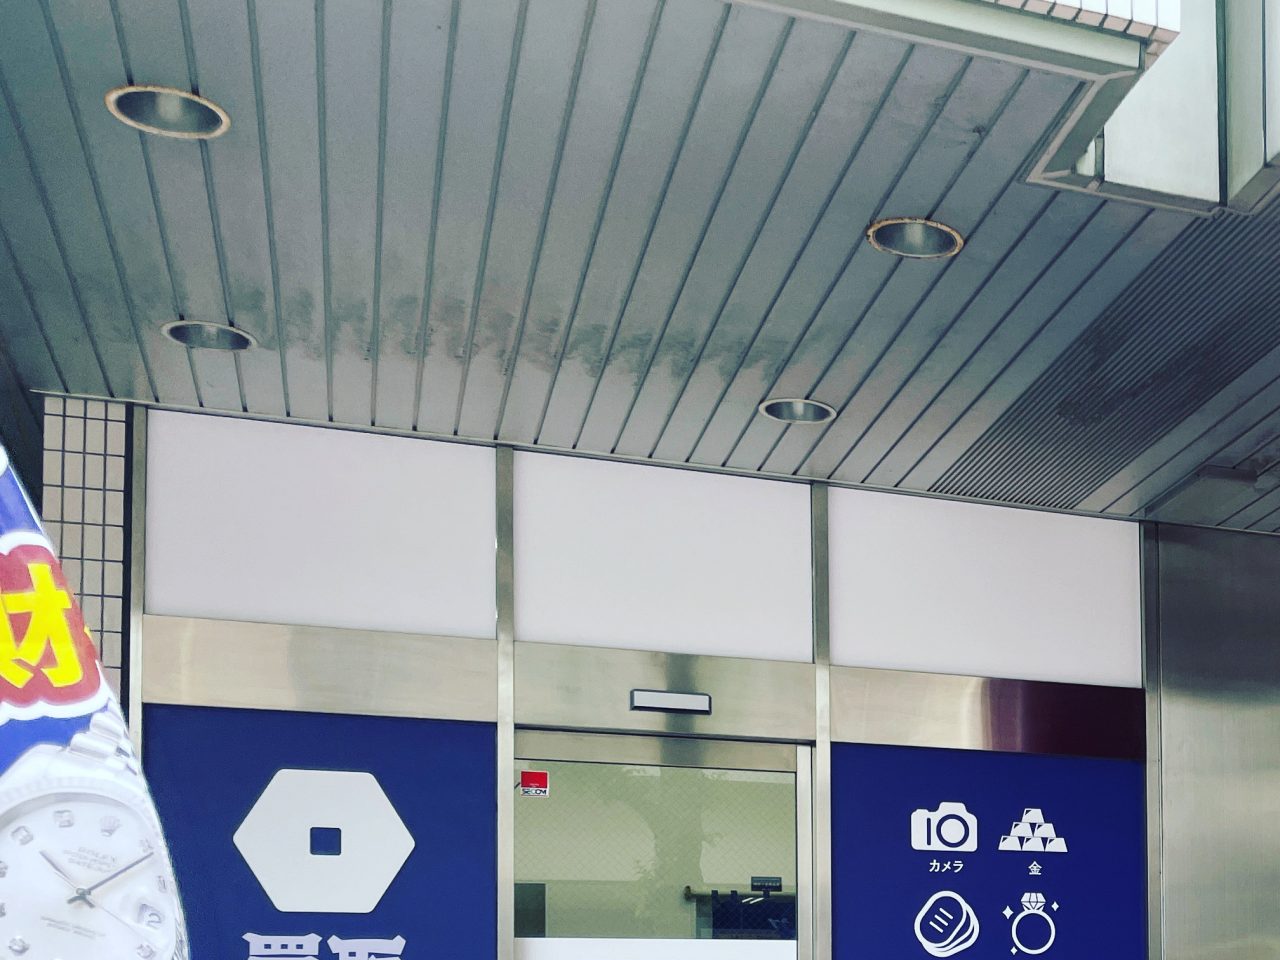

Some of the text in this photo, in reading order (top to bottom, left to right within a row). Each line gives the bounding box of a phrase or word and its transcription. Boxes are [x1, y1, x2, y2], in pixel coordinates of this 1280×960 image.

[521, 788, 548, 796] SECOM
[929, 859, 964, 874] カメラ
[1028, 861, 1042, 876] 金
